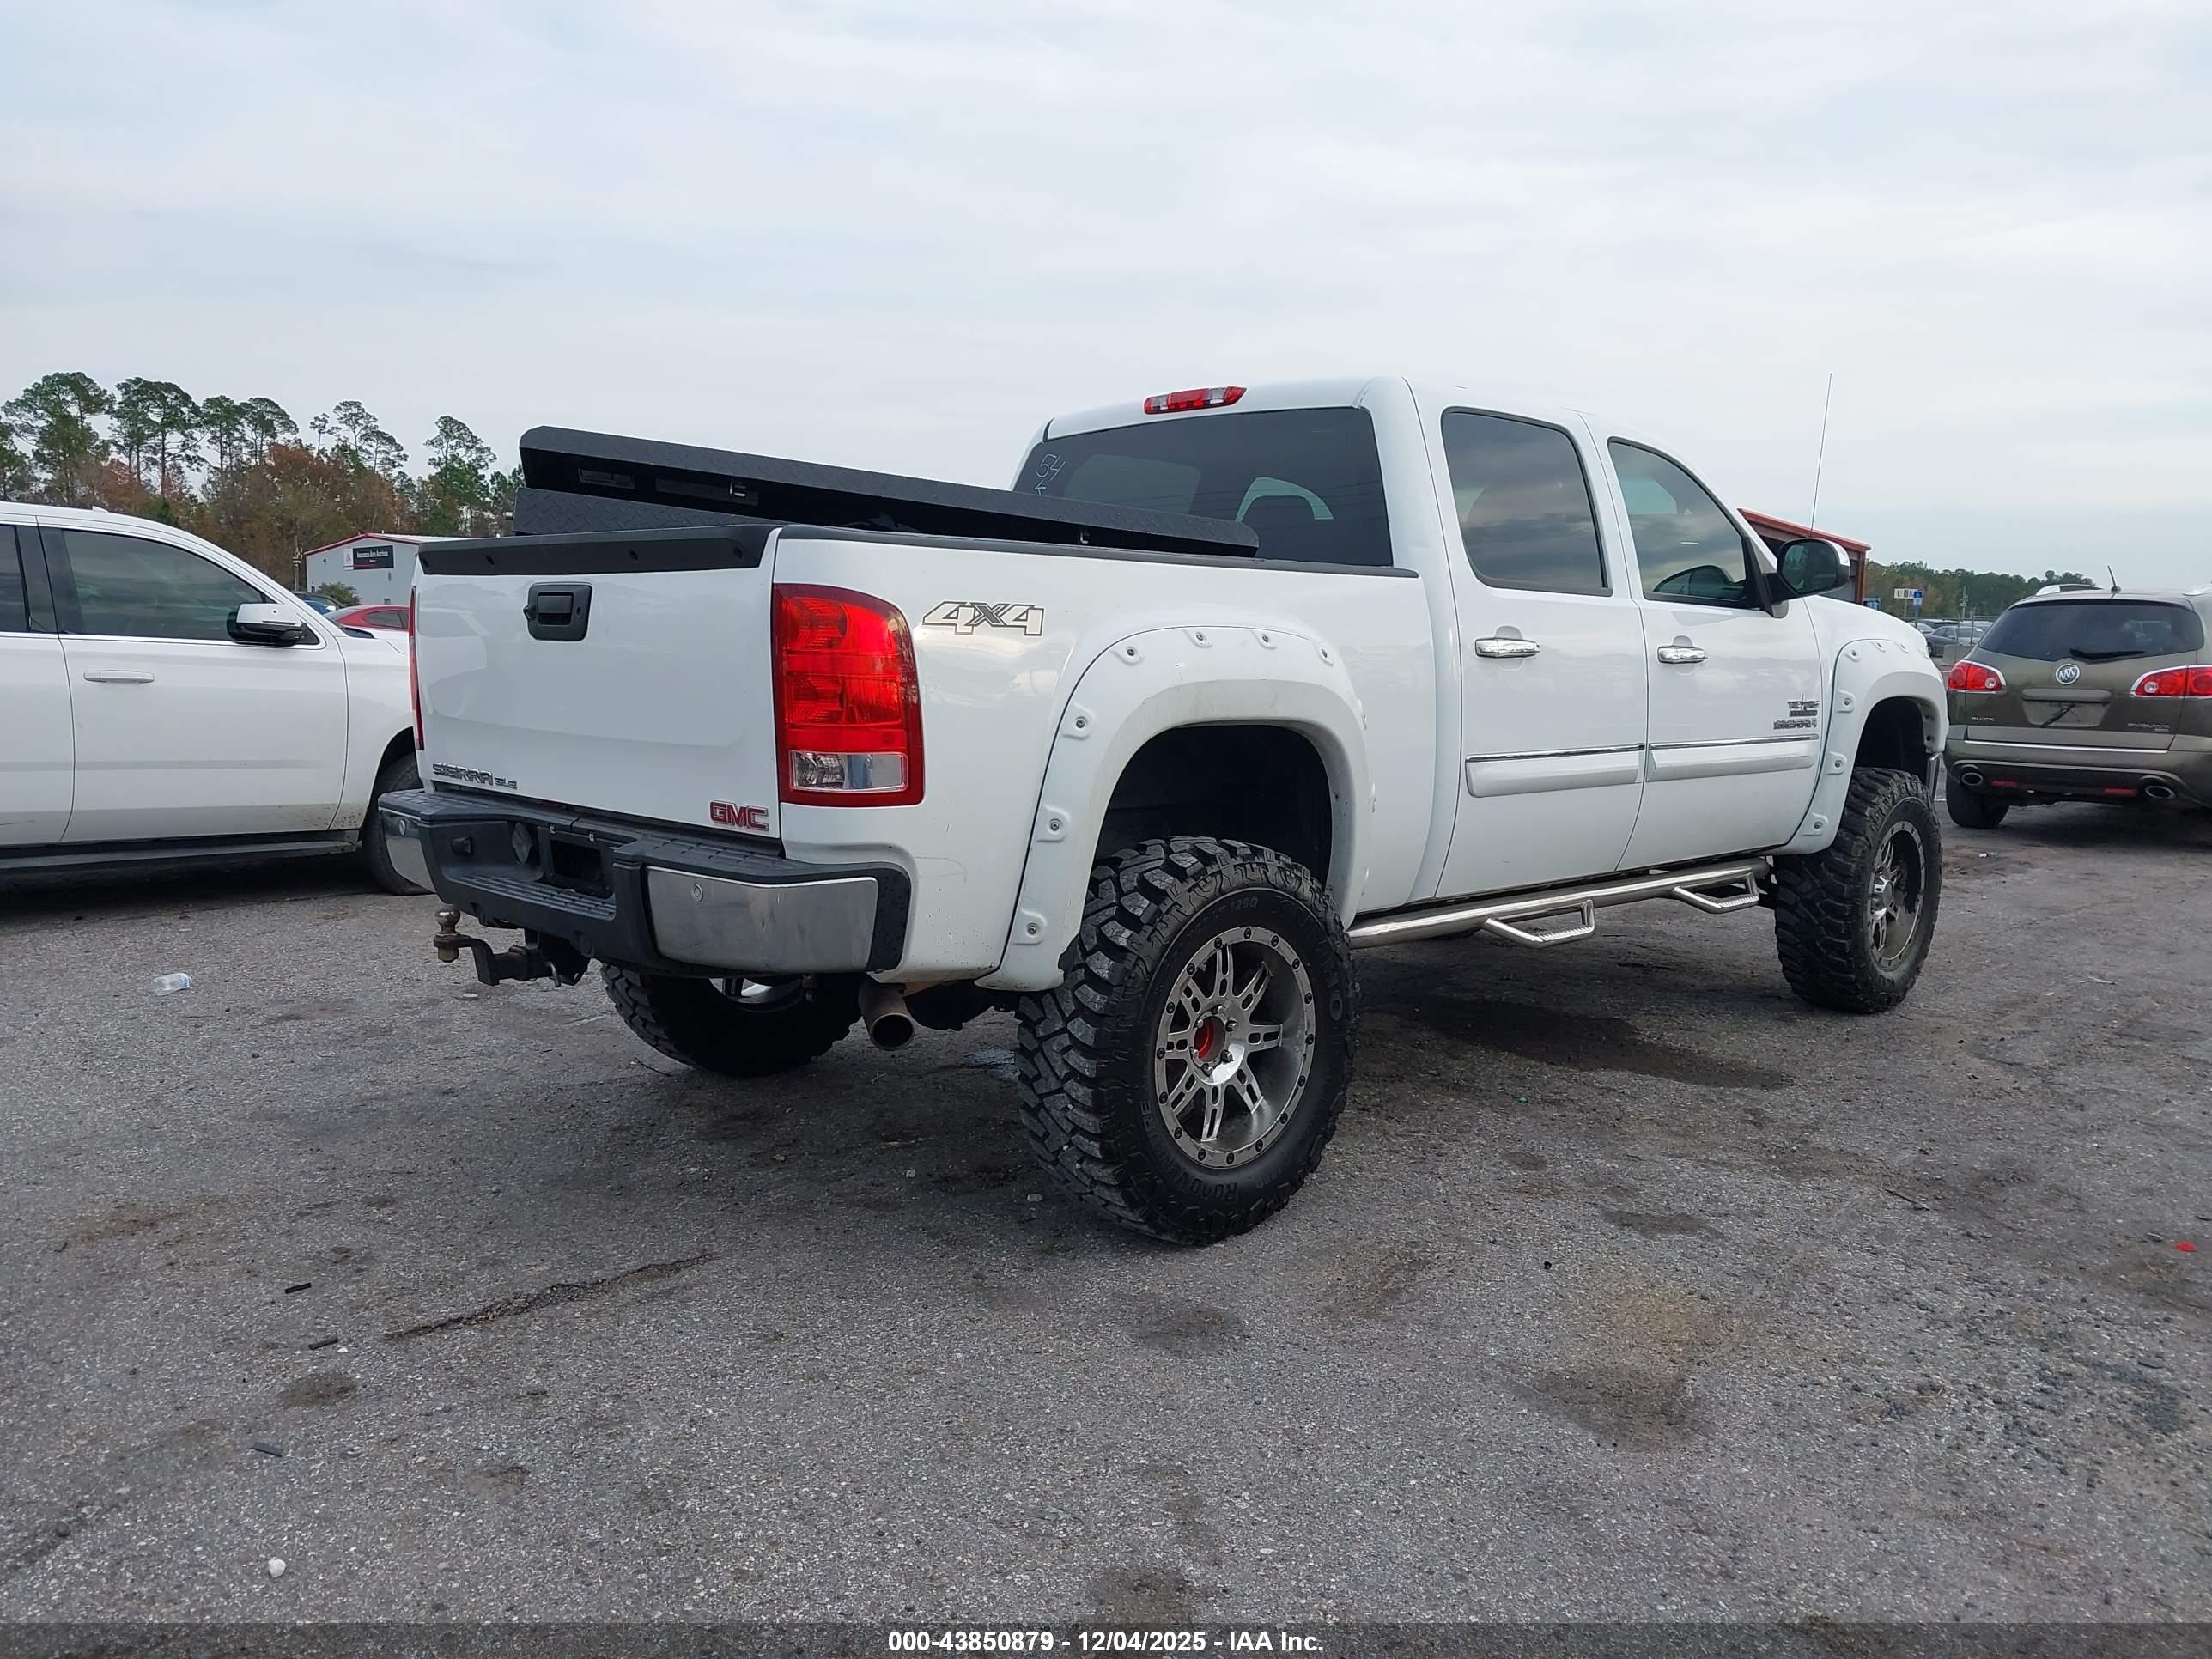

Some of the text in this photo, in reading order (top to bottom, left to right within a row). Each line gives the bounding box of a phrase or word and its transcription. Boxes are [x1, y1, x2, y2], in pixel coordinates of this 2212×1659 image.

[1036, 453, 1066, 482] 54
[922, 600, 1045, 637] 4X4
[431, 762, 519, 791] SIERRA SLE
[709, 800, 770, 832] GMC
